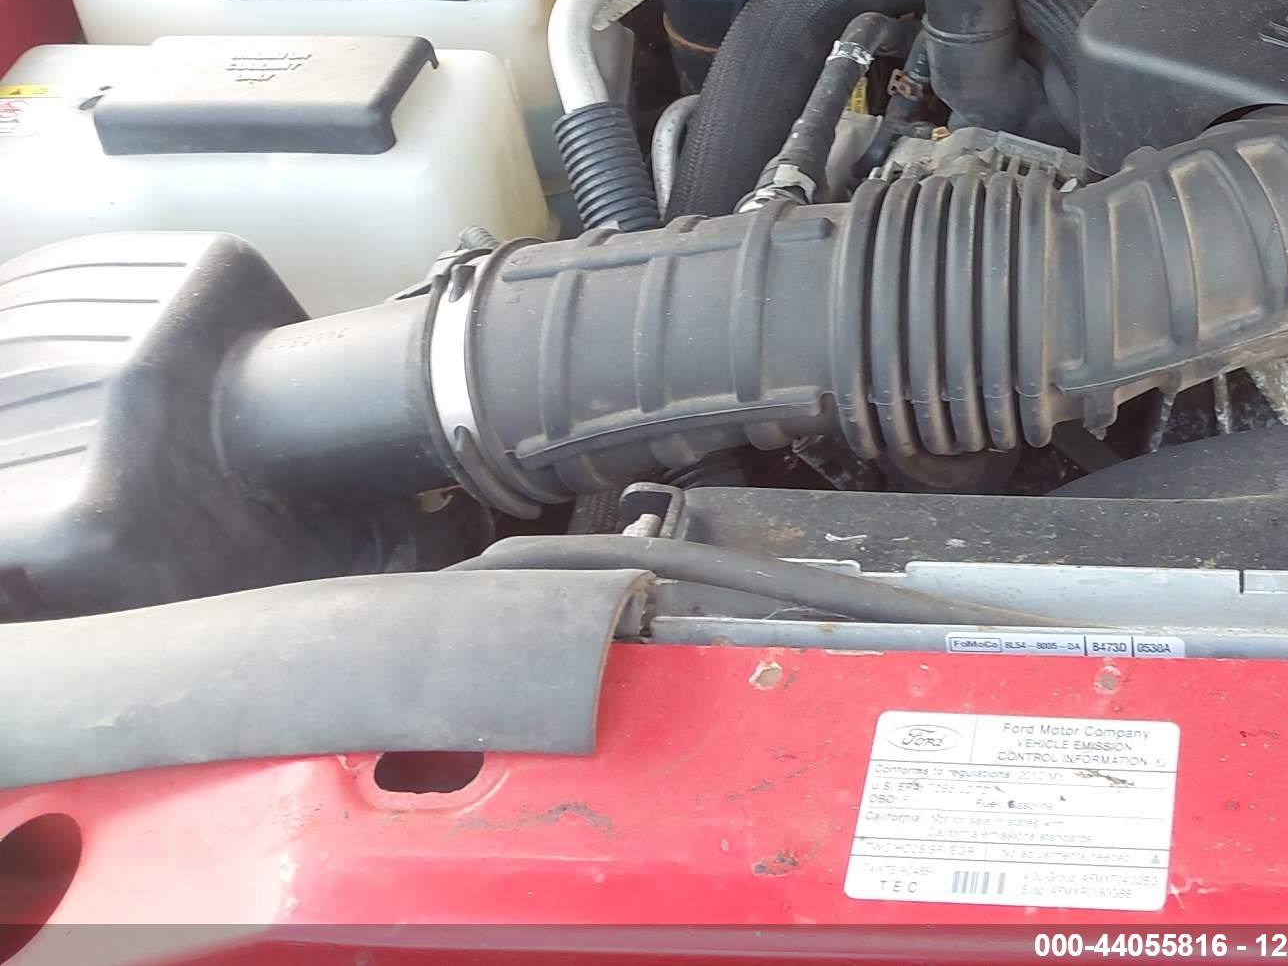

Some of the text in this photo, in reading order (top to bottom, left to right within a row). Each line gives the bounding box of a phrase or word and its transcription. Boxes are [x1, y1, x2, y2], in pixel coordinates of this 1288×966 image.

[953, 639, 998, 649] FoMoCo
[902, 727, 945, 747] Ford
[1003, 722, 1150, 740] Ford Motor Company
[1017, 738, 1133, 751] VEHICLE EMISSION
[998, 751, 1057, 763] CONTROL
[1063, 753, 1148, 766] INFORMATION
